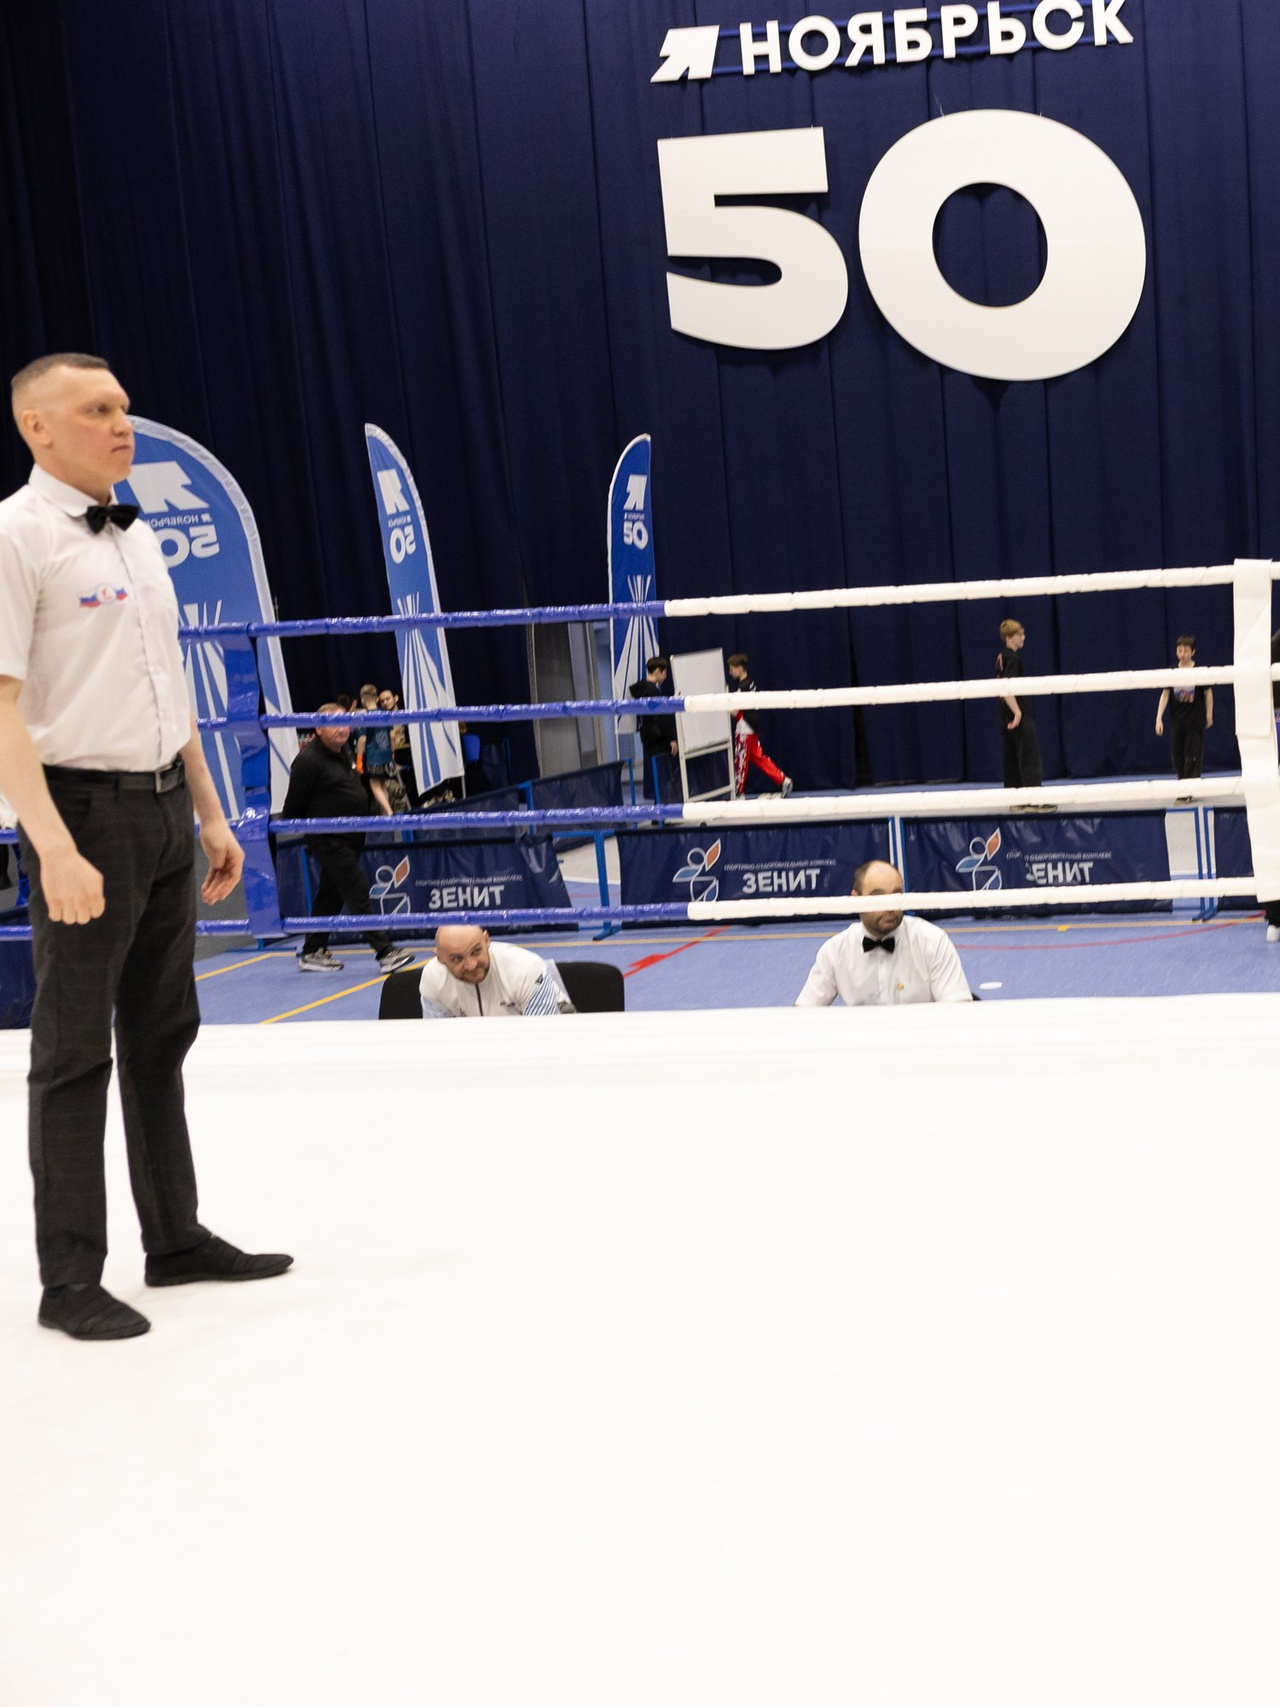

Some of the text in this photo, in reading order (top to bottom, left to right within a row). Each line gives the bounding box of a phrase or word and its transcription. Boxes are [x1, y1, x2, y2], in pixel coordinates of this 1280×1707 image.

[739, 0, 1134, 76] НОЯБРЬСК
[657, 109, 1146, 381] 50
[624, 521, 648, 550] 50
[742, 867, 820, 894] ЗЕНИТ
[428, 884, 505, 910] ЗЕНИТ
